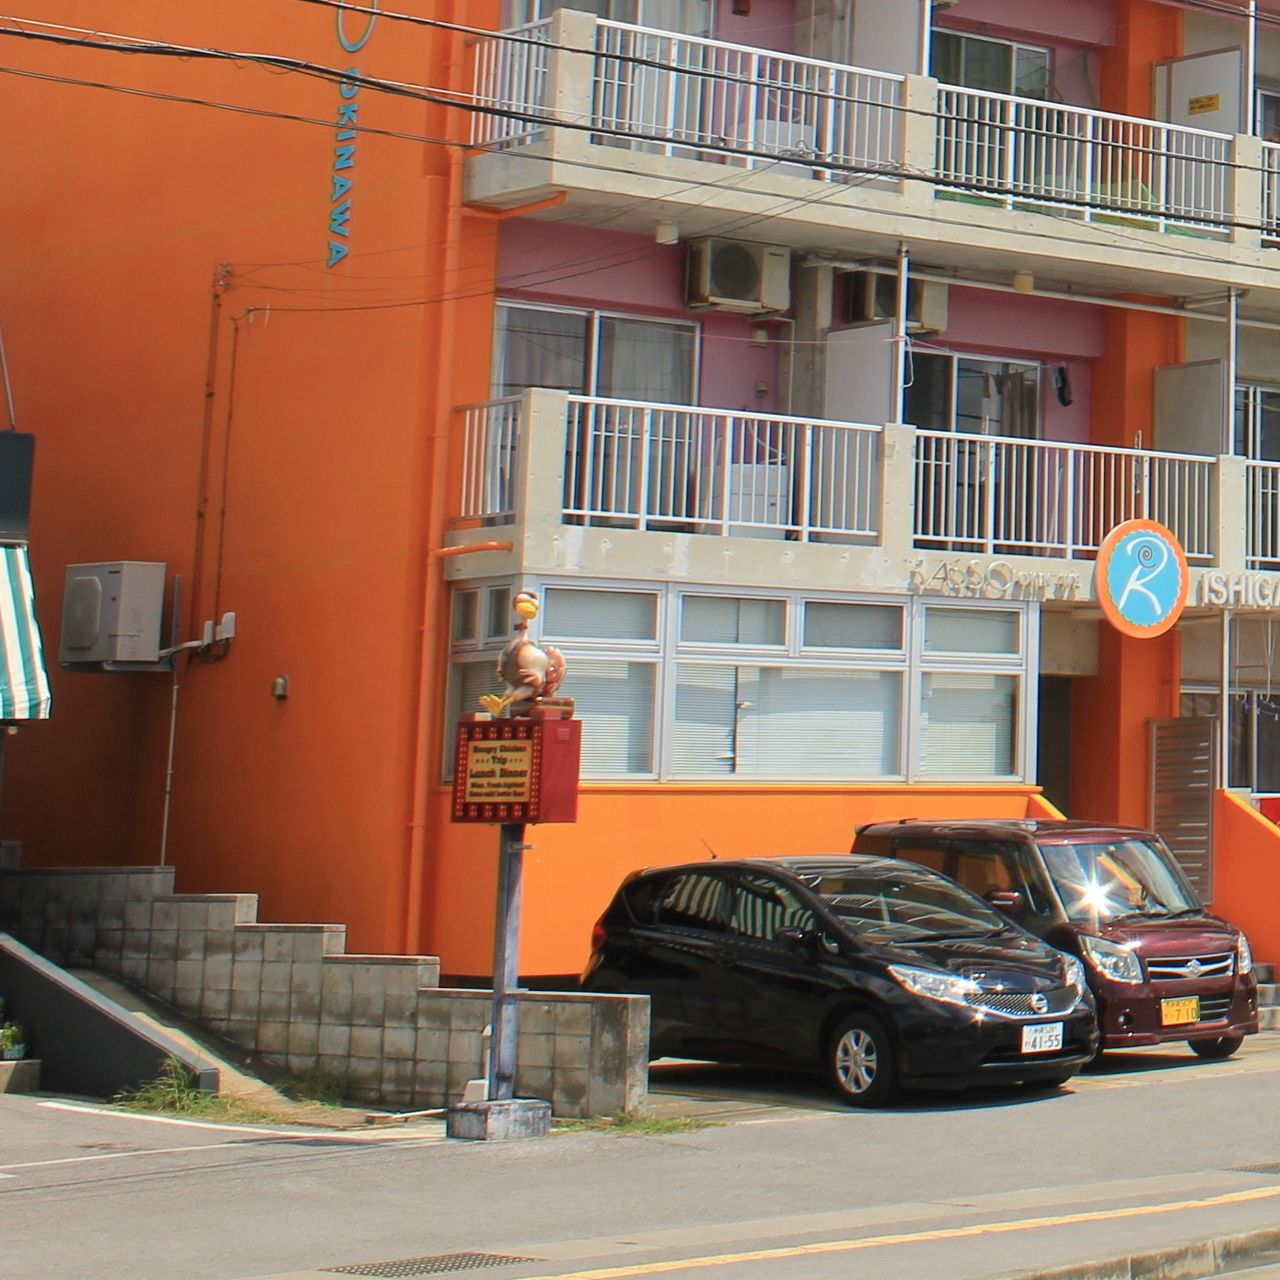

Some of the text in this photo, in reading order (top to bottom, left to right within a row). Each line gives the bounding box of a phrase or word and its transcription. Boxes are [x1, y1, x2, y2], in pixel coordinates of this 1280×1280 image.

[327, 67, 361, 269] OKINAWA
[469, 767, 528, 778] Lunch Dinner
